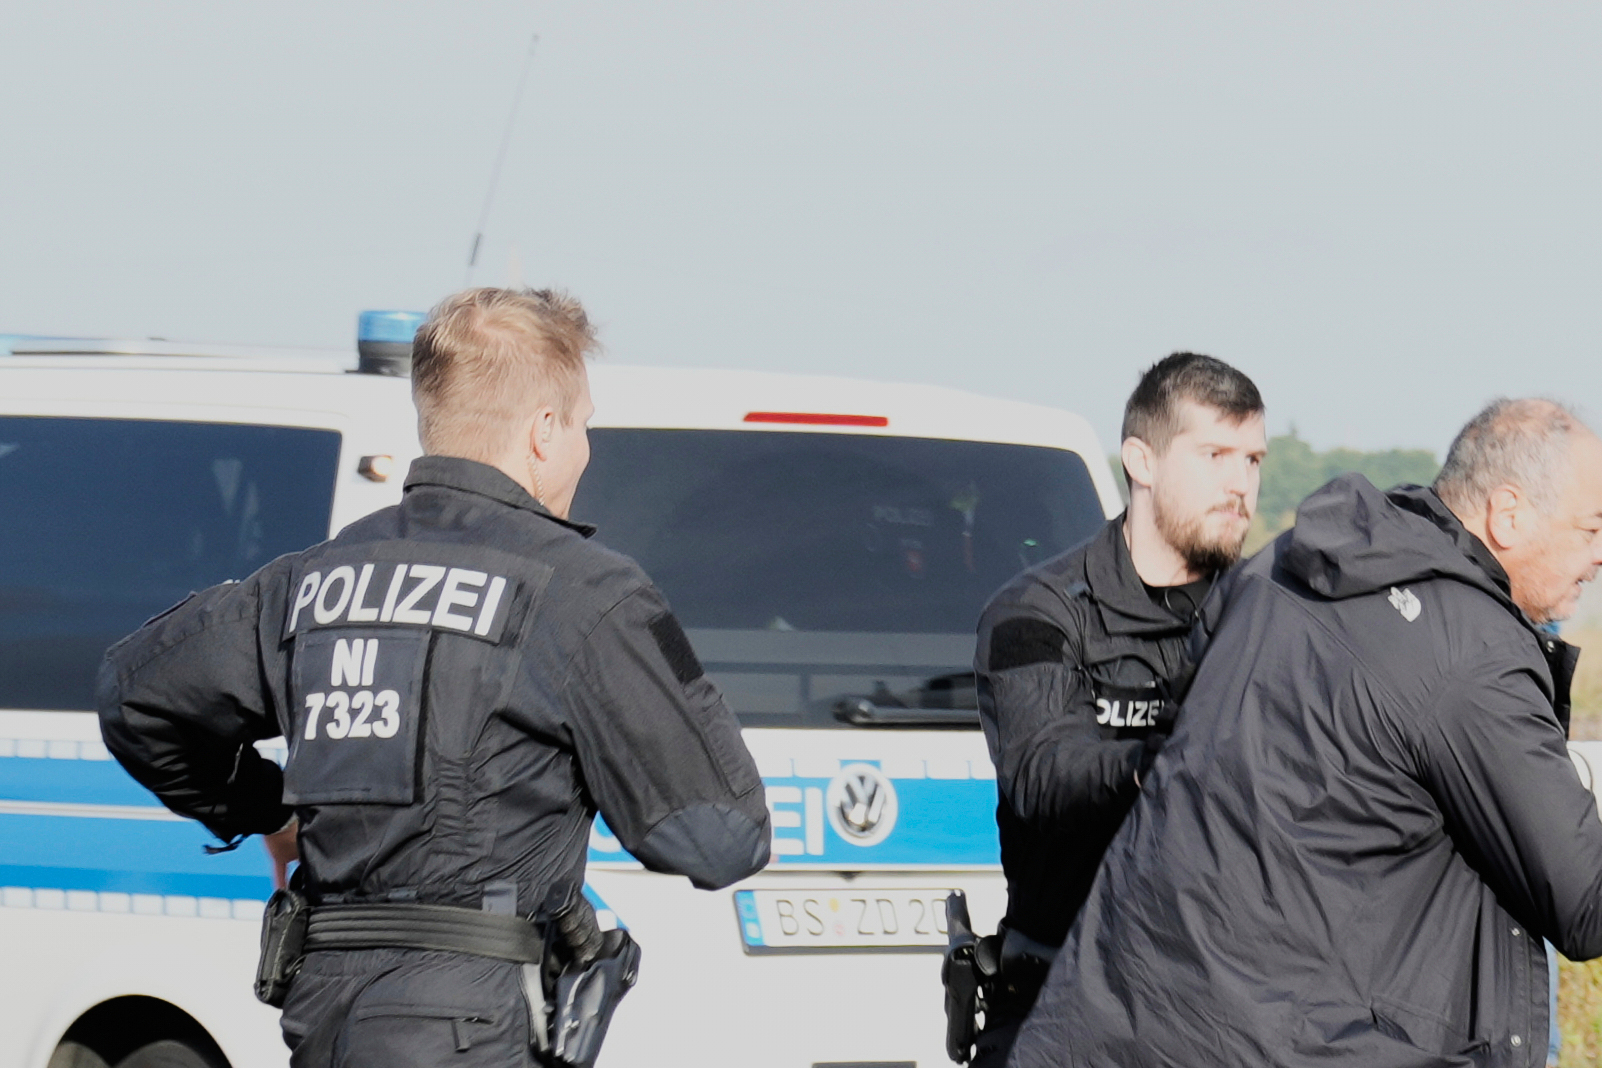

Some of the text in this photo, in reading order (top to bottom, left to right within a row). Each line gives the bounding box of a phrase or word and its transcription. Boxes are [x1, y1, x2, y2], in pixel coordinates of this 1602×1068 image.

[288, 563, 507, 636] POLIZEI
[330, 638, 379, 687] NI
[304, 689, 401, 741] 7323
[1096, 697, 1165, 728] OLIZE
[775, 898, 825, 937] BS
[850, 898, 900, 936] ZD
